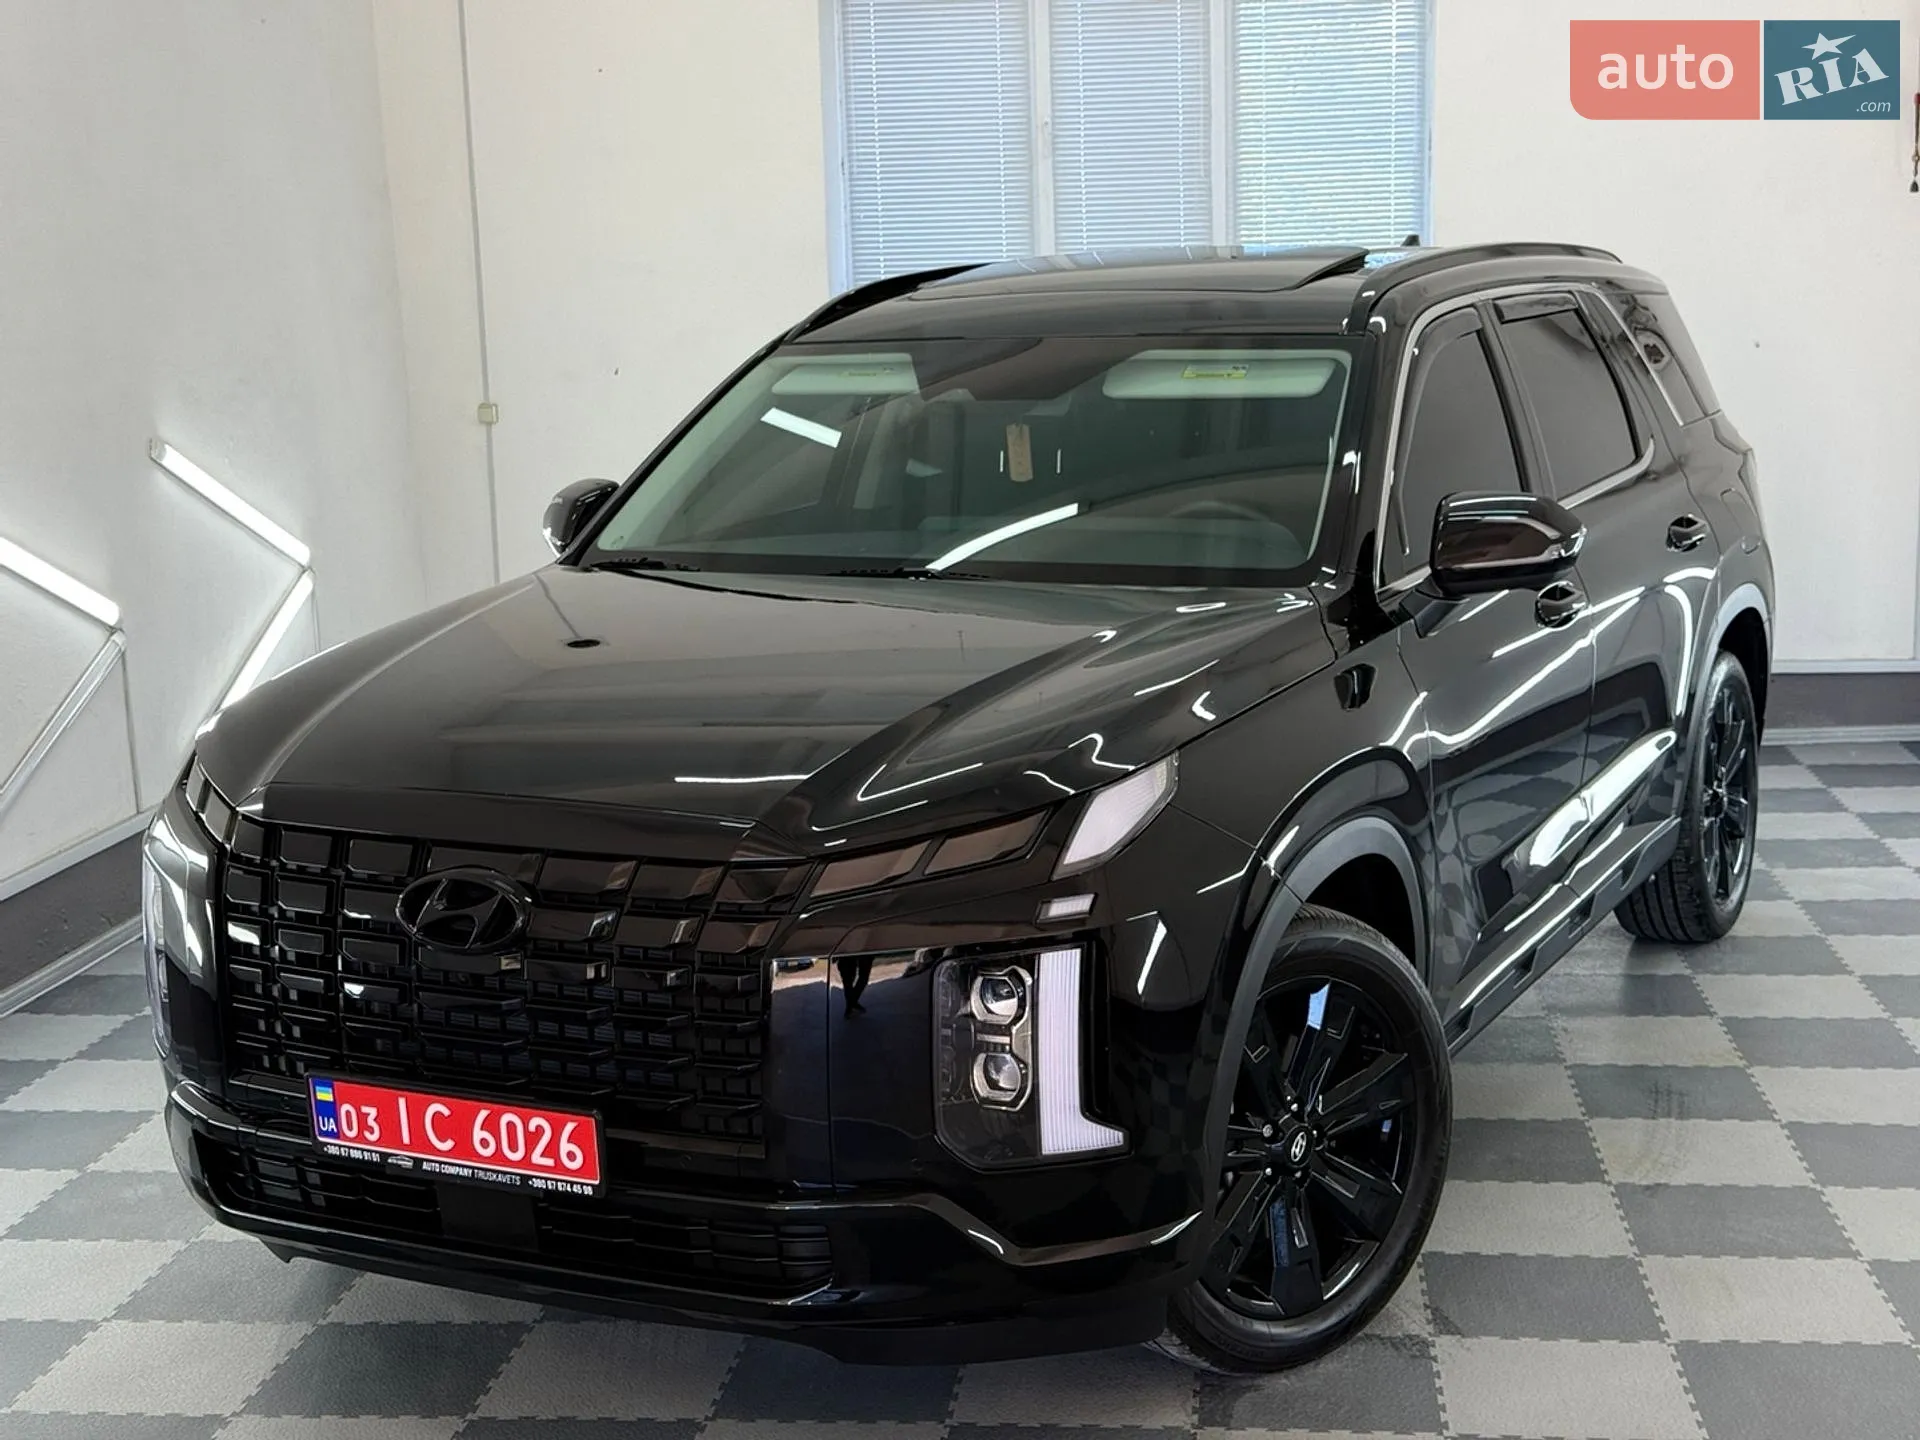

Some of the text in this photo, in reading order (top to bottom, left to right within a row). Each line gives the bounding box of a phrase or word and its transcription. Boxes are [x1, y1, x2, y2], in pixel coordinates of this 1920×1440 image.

[318, 1115, 338, 1133] UA
[340, 1102, 381, 1142] 03
[472, 1108, 584, 1171] 6026
[422, 1161, 440, 1173] AUTO
[440, 1163, 473, 1178] COMPANY
